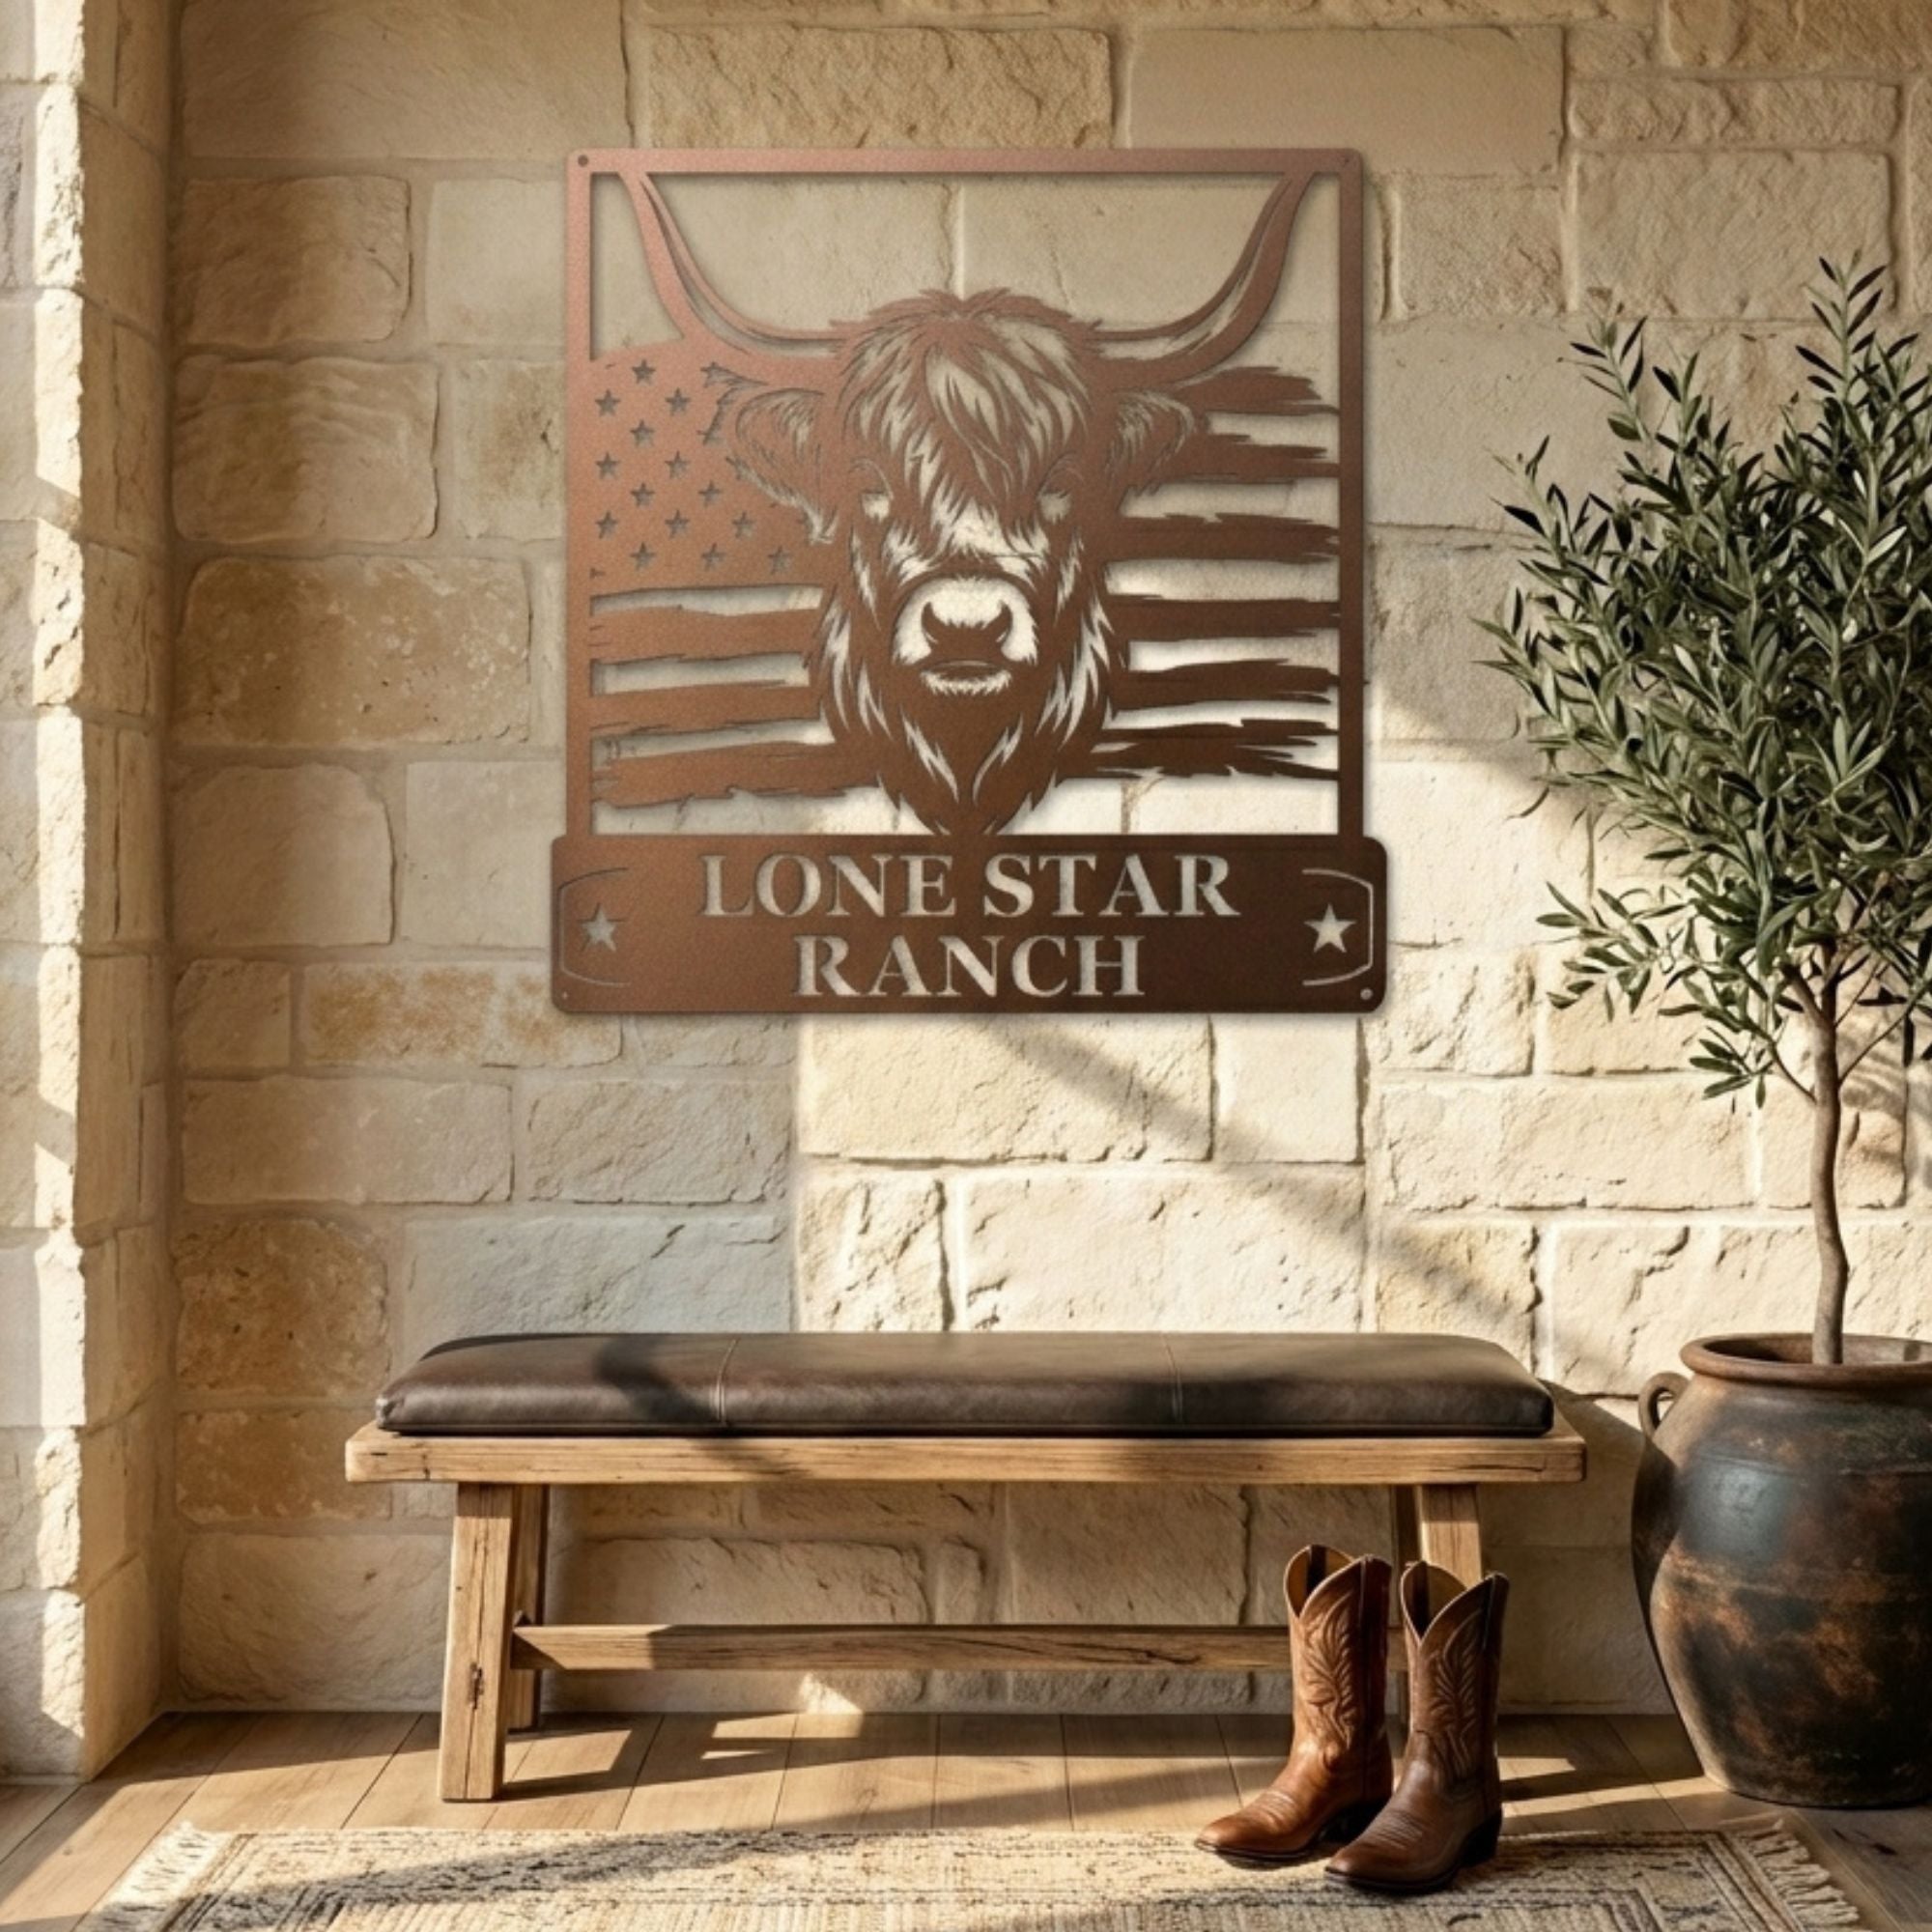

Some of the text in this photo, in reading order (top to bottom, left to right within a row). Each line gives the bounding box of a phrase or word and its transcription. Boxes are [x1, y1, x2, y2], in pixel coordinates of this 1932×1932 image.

[701, 853, 1241, 918] LONE STAR
[794, 934, 1147, 998] RANCH
